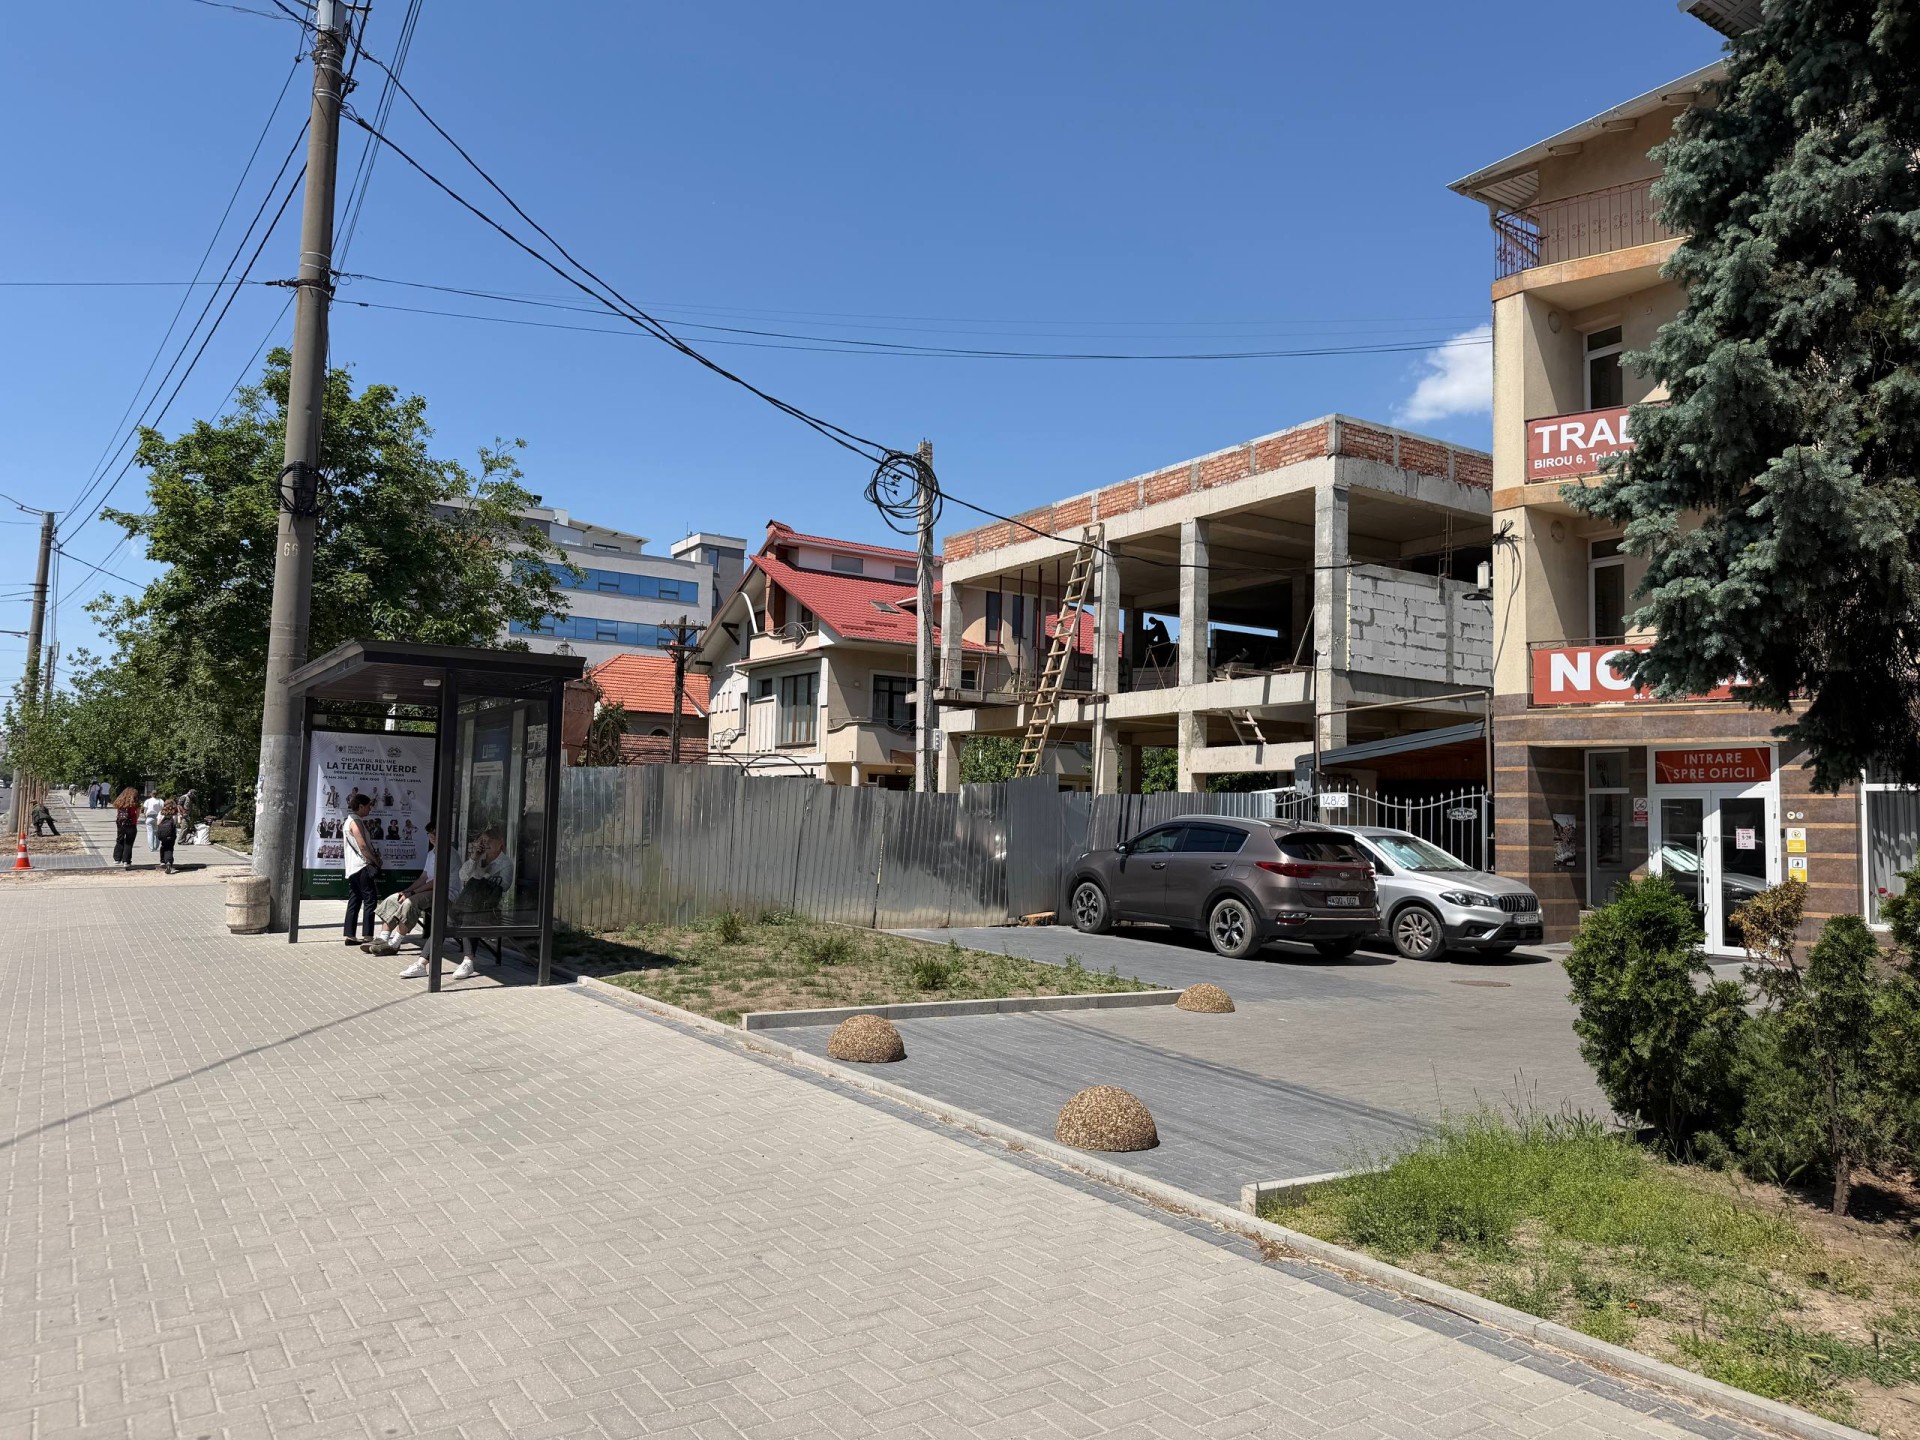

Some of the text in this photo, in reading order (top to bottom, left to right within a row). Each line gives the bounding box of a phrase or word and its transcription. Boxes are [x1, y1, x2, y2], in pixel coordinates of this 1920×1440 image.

[1534, 455, 1572, 469] BIROU
[1575, 454, 1586, 465] 6,
[1684, 752, 1742, 765] INTRARE
[326, 762, 417, 773] LA TEATRUL VERDE
[1673, 766, 1755, 779] SPRE OFICII
[1322, 795, 1347, 806] 148/3
